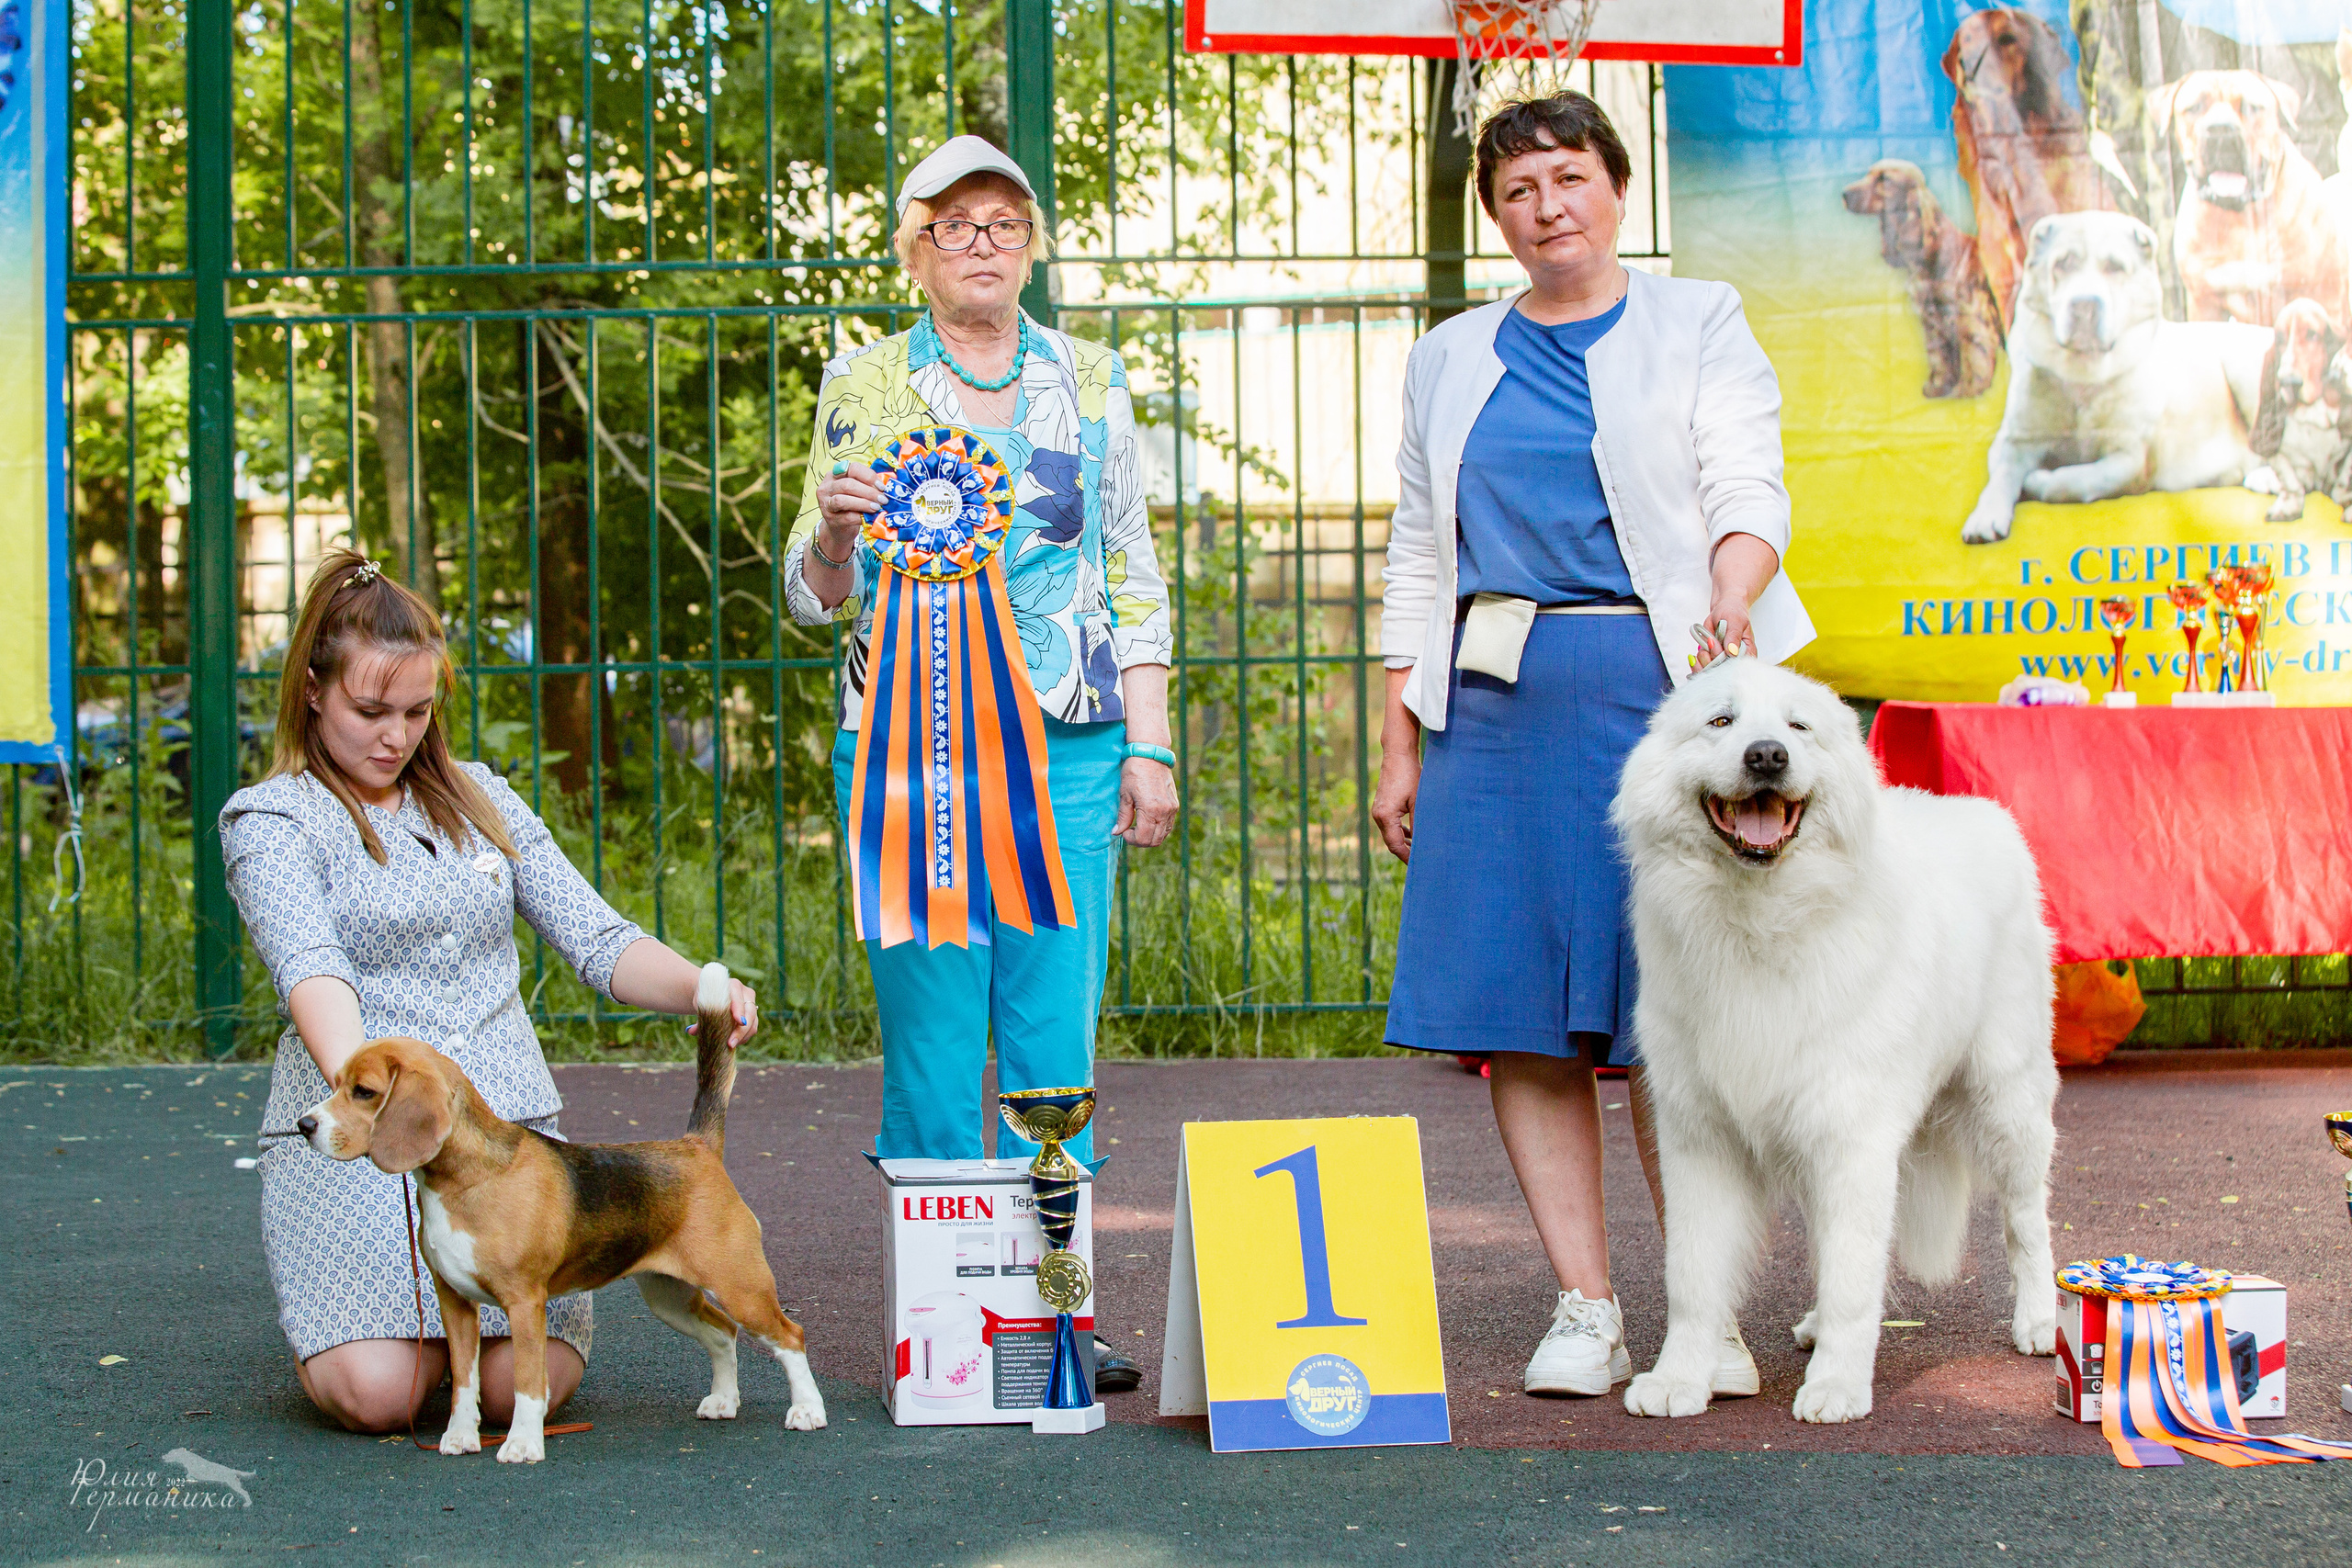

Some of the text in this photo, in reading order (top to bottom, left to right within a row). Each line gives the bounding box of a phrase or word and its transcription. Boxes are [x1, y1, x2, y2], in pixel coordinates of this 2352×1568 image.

[926, 505, 954, 514] ДРУГ
[2020, 559, 2053, 585] г.
[903, 1196, 993, 1221] LEBEN
[1253, 1145, 1368, 1329] 1
[1300, 1360, 1358, 1382] СЕРГИЕВ ПОСАД
[1309, 1385, 1356, 1397] ВЕРНЫЙ
[1307, 1396, 1357, 1413] ДРУГ
